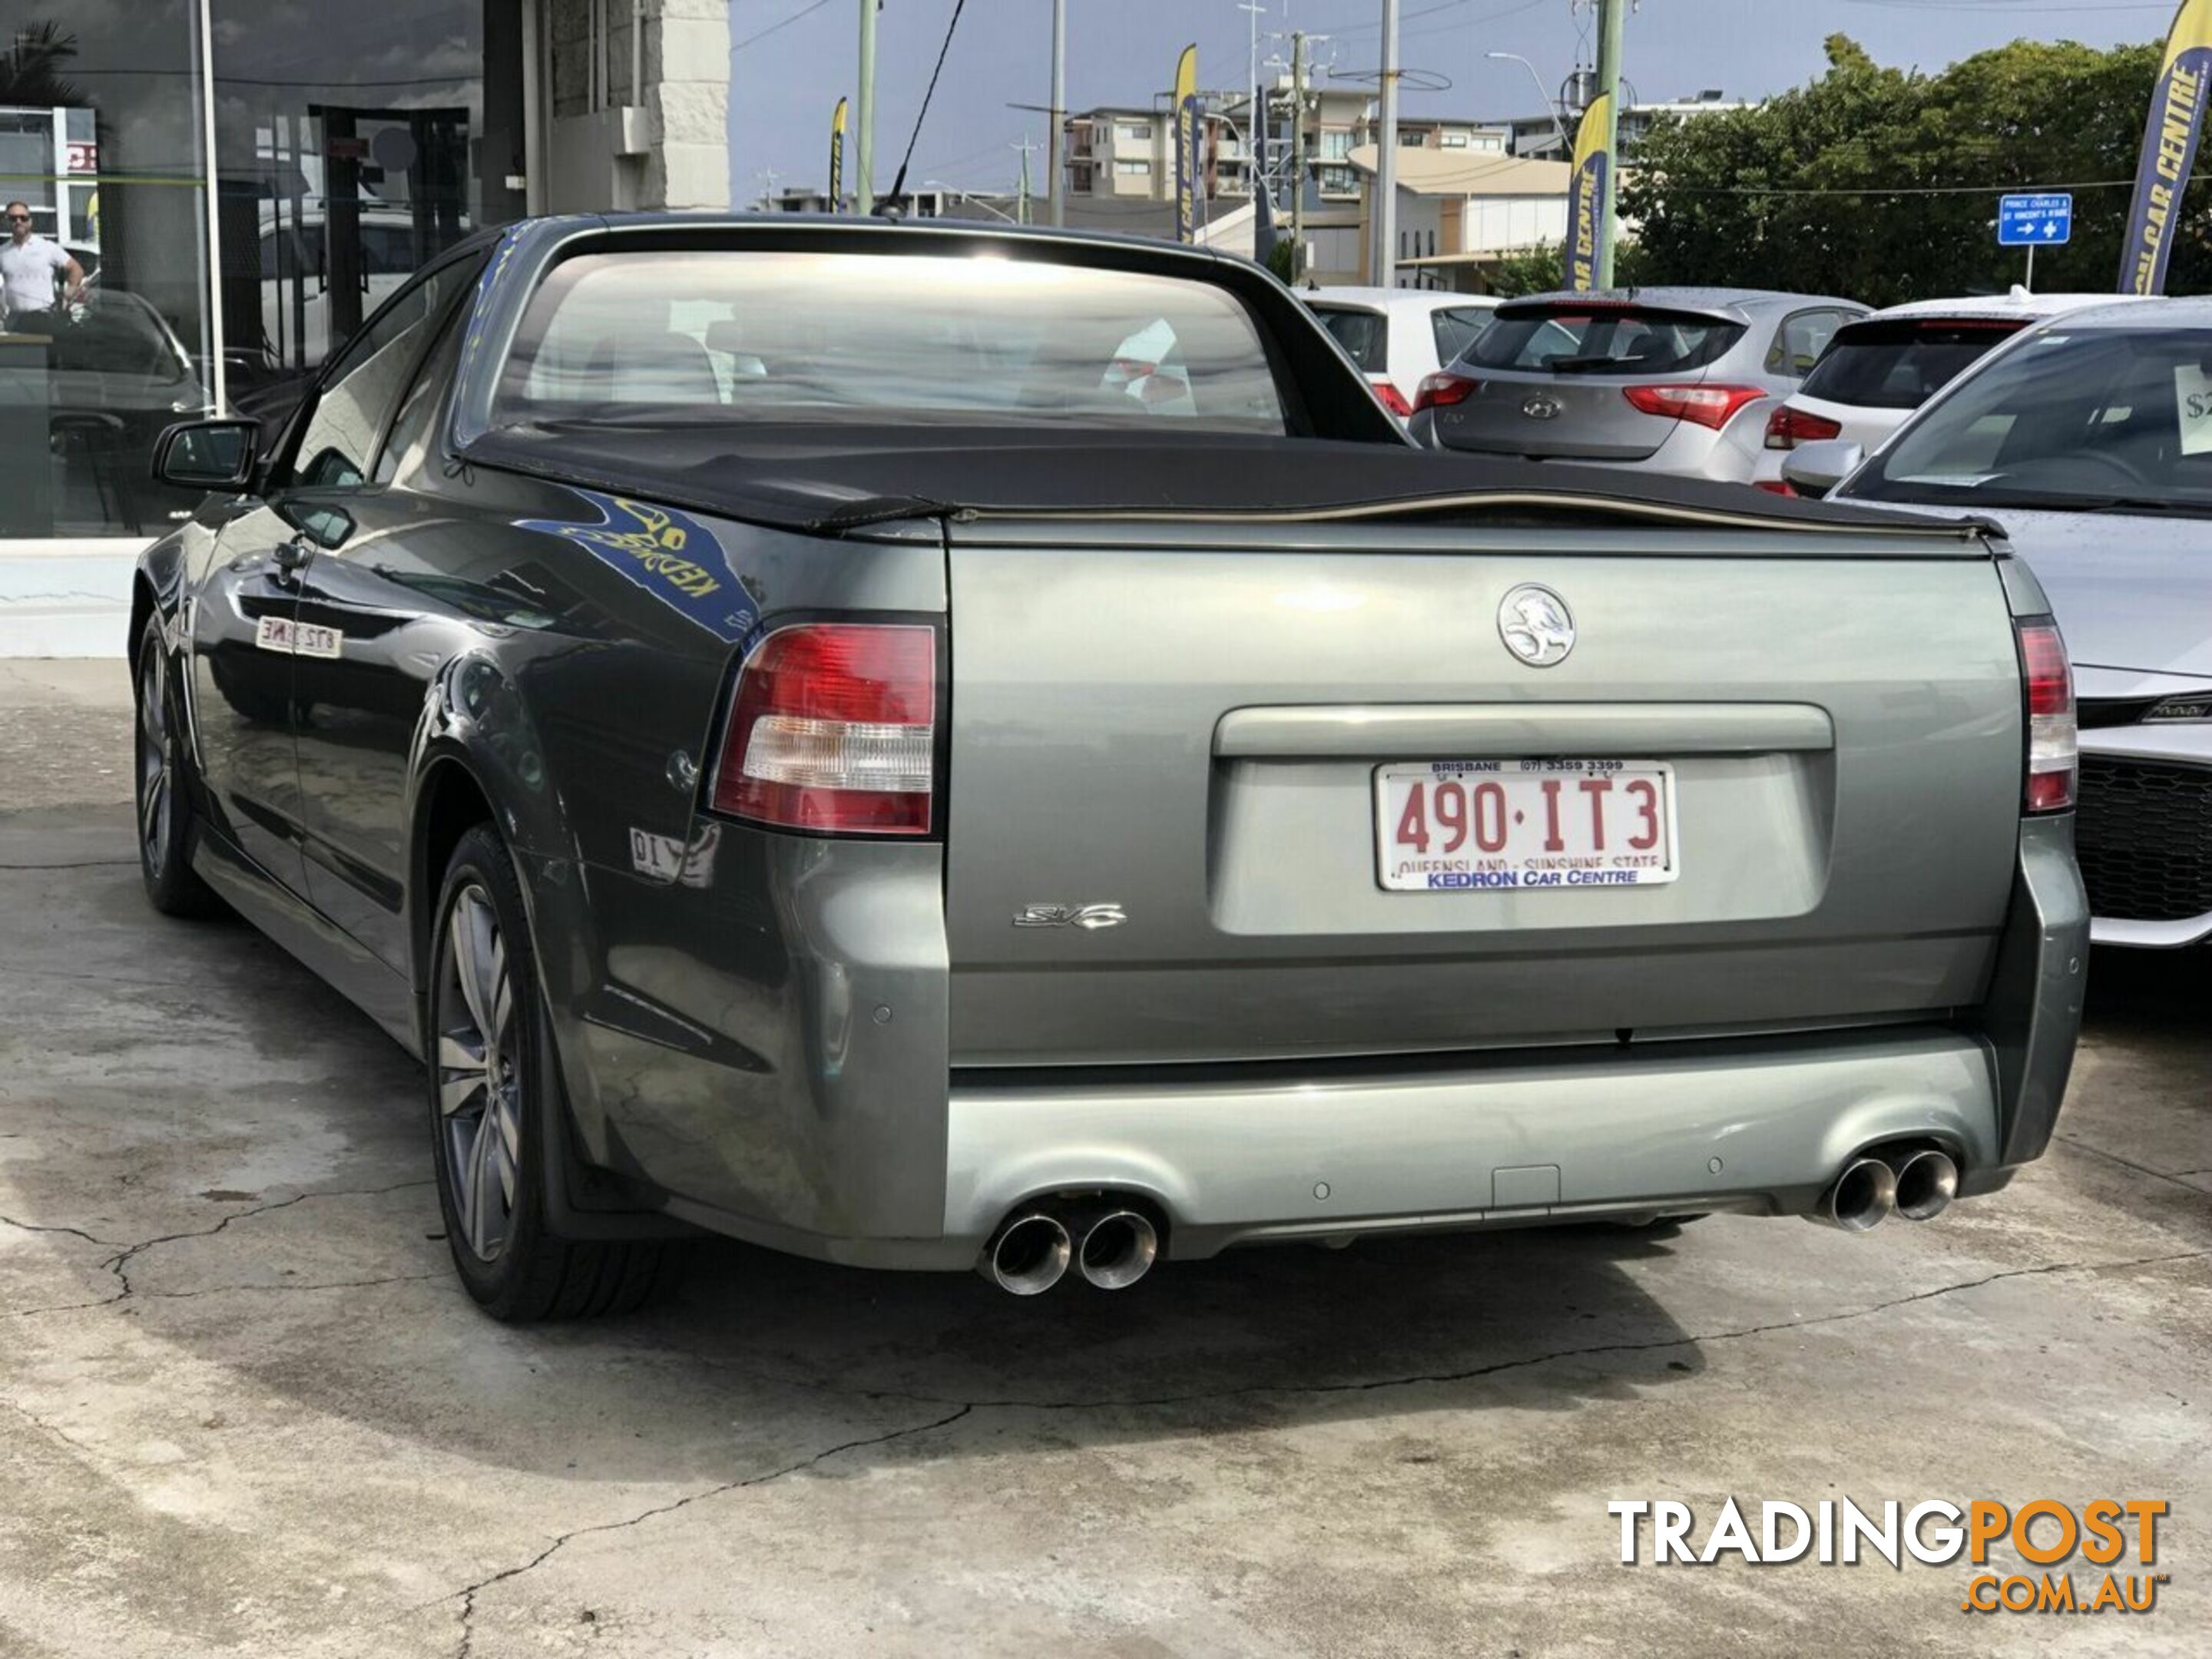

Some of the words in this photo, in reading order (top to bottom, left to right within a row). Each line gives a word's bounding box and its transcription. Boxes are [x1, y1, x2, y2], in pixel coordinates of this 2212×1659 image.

[2155, 61, 2198, 181] CENTRE
[1576, 165, 1598, 257] CENTRE
[2004, 200, 2028, 209] PRINCE
[2030, 199, 2060, 208] CHARLES
[2144, 183, 2173, 248] CAR
[1431, 761, 1502, 773] BRISBANE
[1520, 760, 1541, 771] (07)
[1587, 760, 1624, 770] 3399
[1399, 857, 1508, 873] QUEENSLAND
[1525, 857, 1604, 870] SUNSHINE
[1613, 855, 1659, 869] STATE
[1428, 871, 1518, 889] KEDRON
[1524, 870, 1561, 886] CAR
[1567, 869, 1638, 885] CENTRE
